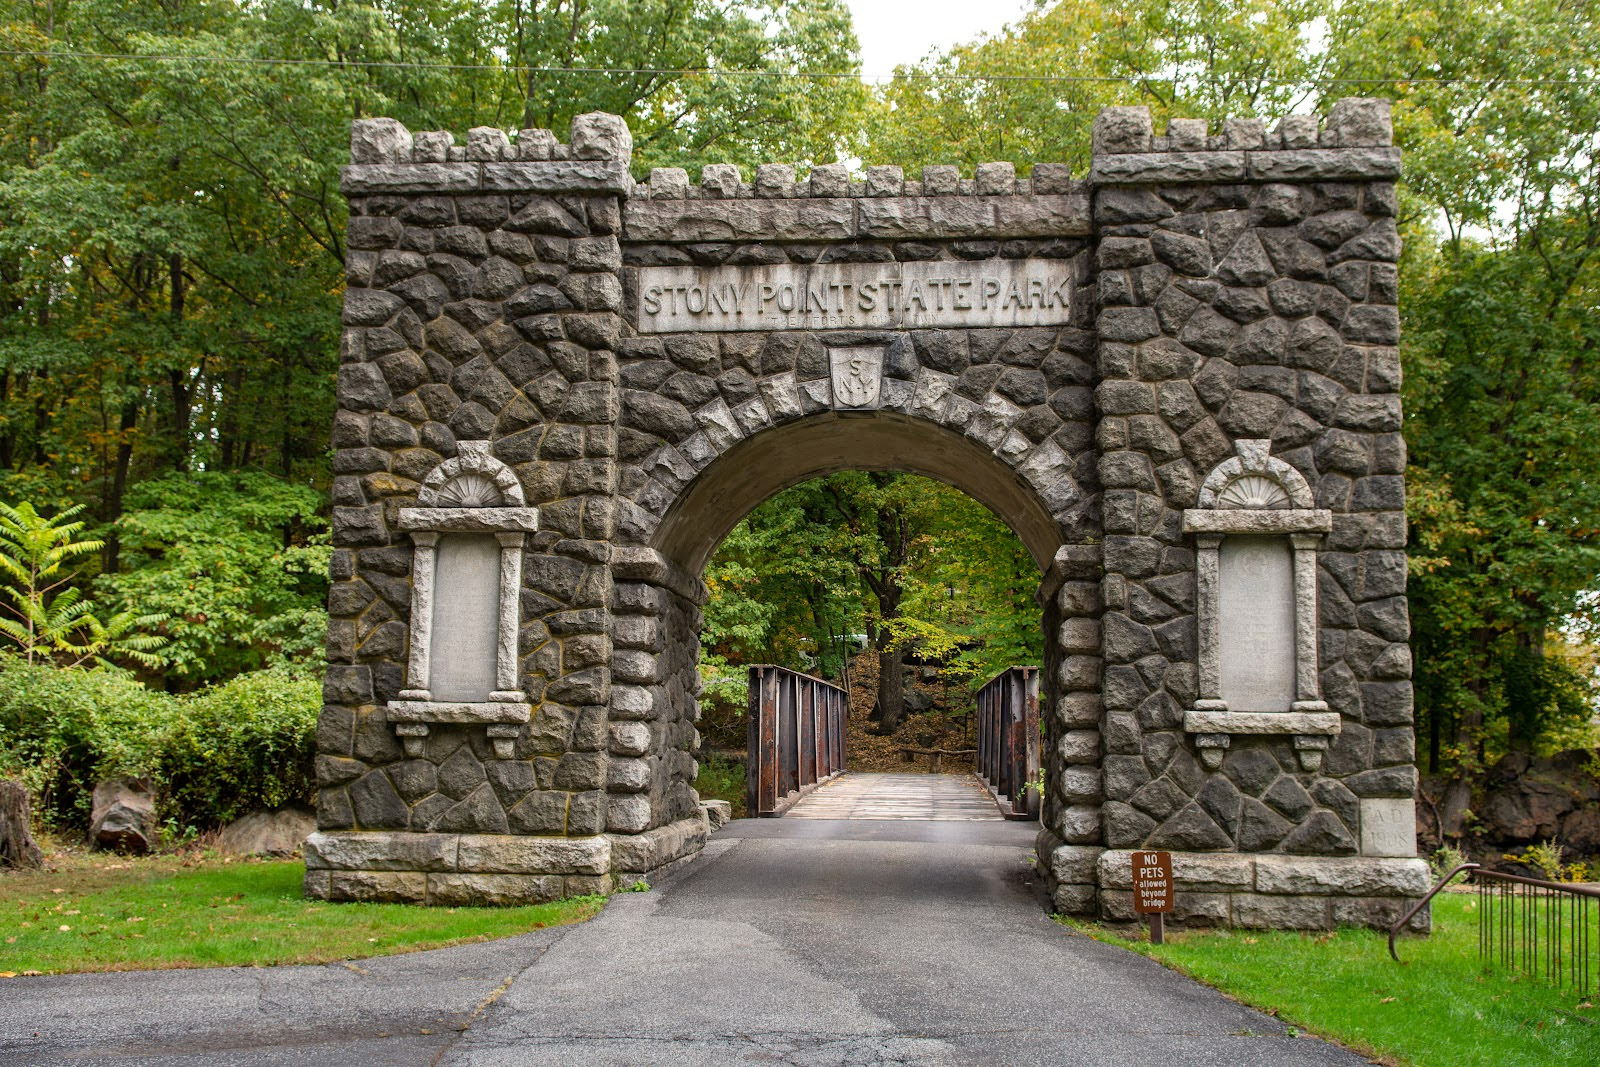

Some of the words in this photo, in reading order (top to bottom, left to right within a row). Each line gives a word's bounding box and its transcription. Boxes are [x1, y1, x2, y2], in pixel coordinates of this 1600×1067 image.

[644, 283, 749, 315] STONY
[757, 281, 851, 314] POINT
[859, 278, 972, 312] STATE
[981, 276, 1070, 310] PARK
[850, 358, 862, 376] S
[1144, 854, 1158, 865] NO
[1140, 867, 1164, 878] PETS
[1139, 880, 1167, 888] allowed
[1141, 889, 1166, 898] beyond
[1143, 899, 1165, 908] bridge
